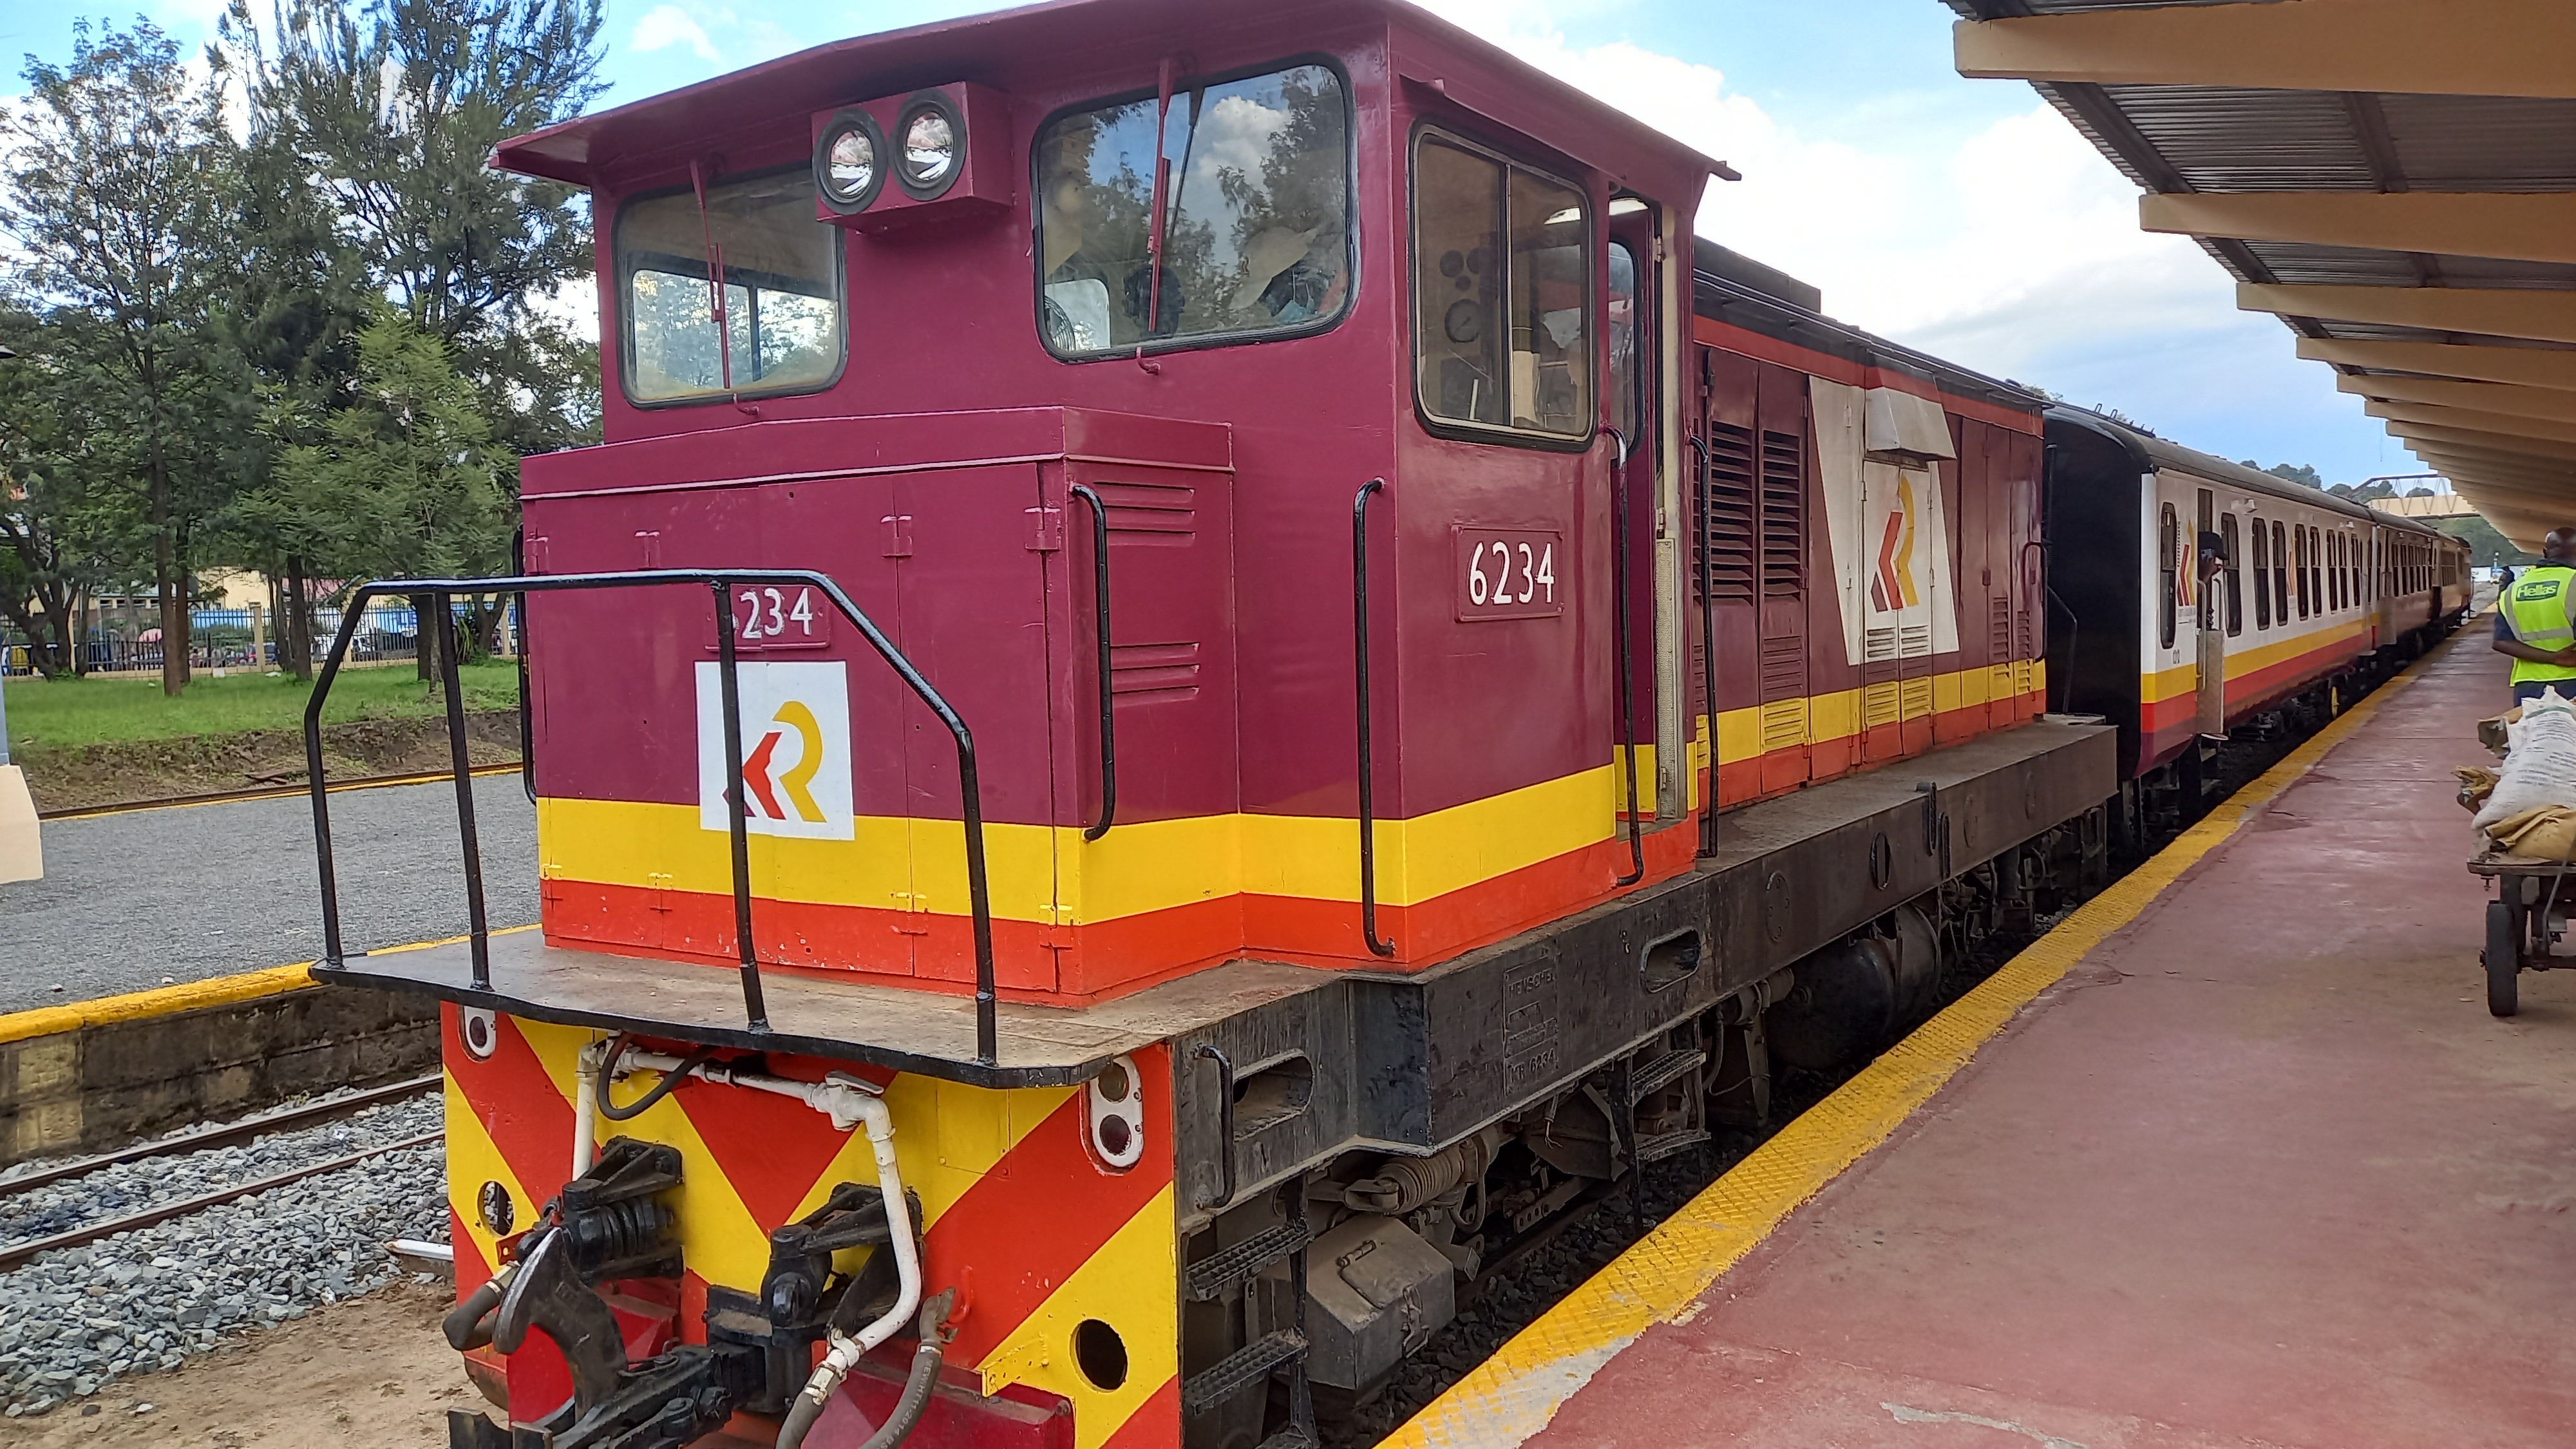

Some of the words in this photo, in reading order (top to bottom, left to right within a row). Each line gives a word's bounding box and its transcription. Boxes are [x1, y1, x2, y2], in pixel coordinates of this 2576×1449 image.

[1469, 541, 1555, 605] 6234
[2517, 583, 2557, 598] Hellas
[732, 587, 813, 639] 234
